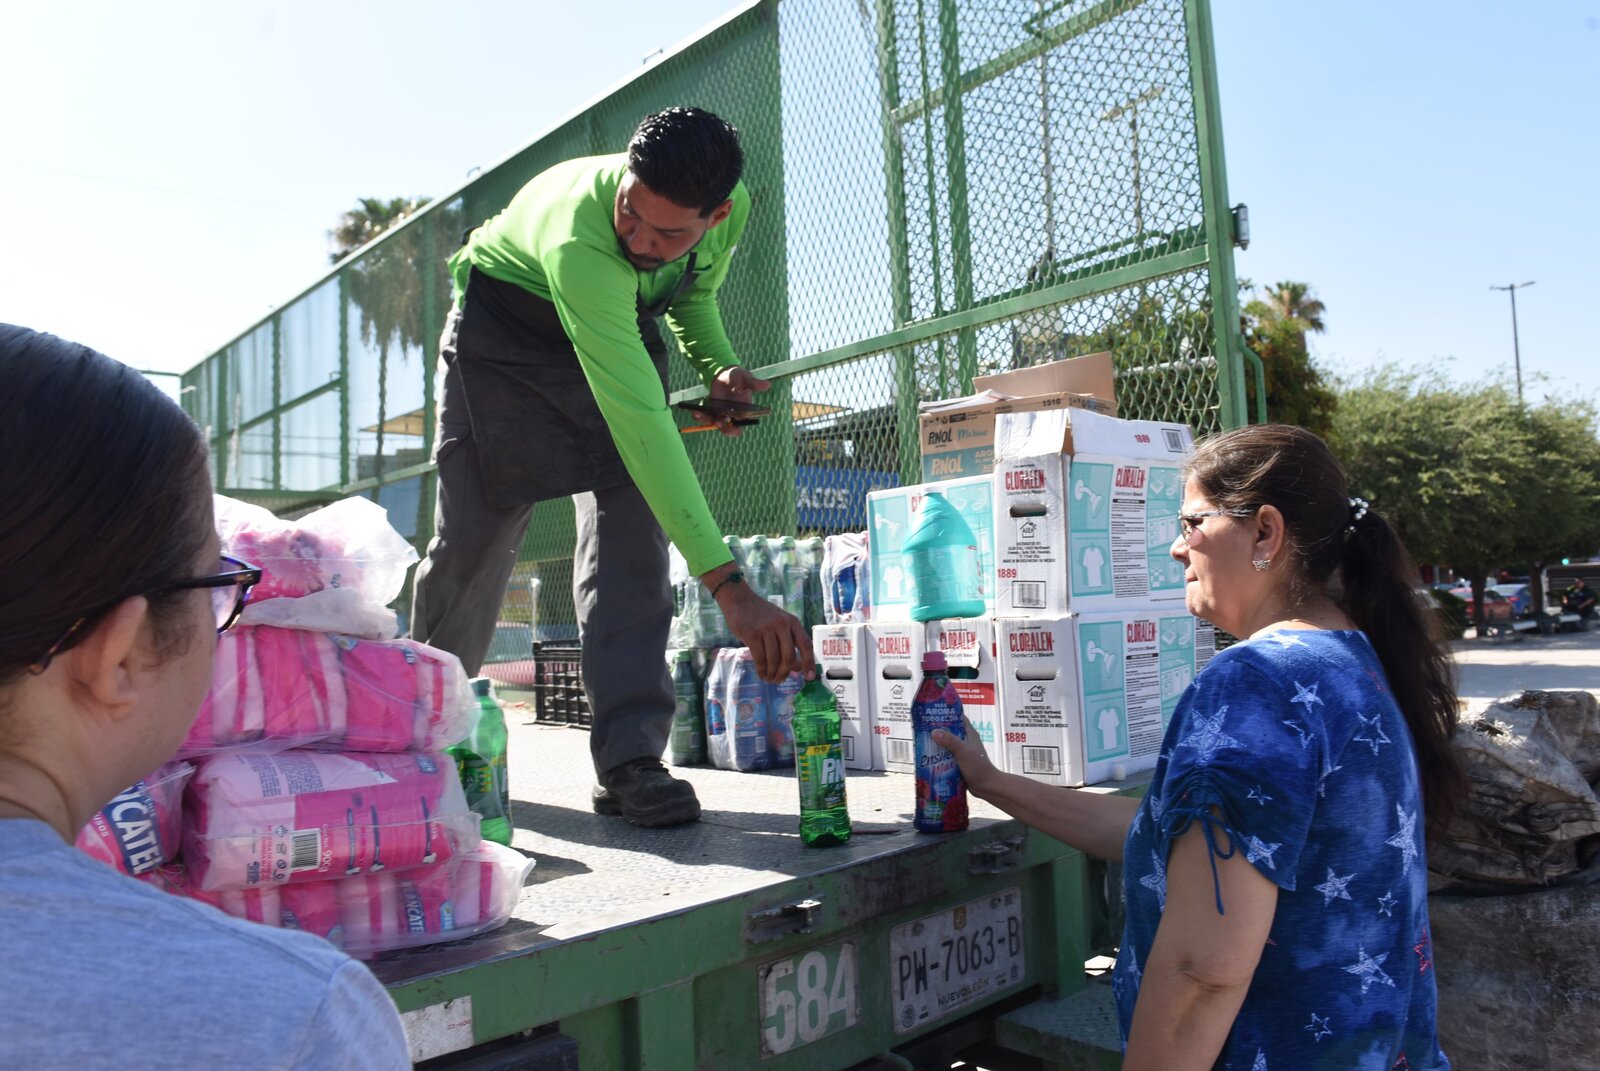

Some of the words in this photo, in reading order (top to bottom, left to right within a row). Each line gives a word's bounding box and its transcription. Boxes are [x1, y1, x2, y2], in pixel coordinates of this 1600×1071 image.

[1005, 470, 1045, 490] CLORALEN
[1115, 467, 1145, 488] CLORALEN
[997, 568, 1017, 578] 1889
[939, 631, 976, 650] CLORALEN
[1009, 632, 1053, 652] CLORALEN
[1126, 622, 1156, 643] CLORALEN
[822, 639, 852, 655] CLORALEN
[878, 637, 911, 654] CLORALEN
[874, 726, 890, 735] 1889
[1005, 732, 1026, 742] 1889
[898, 916, 1020, 1001] PW-7063-B
[764, 942, 857, 1055] 584
